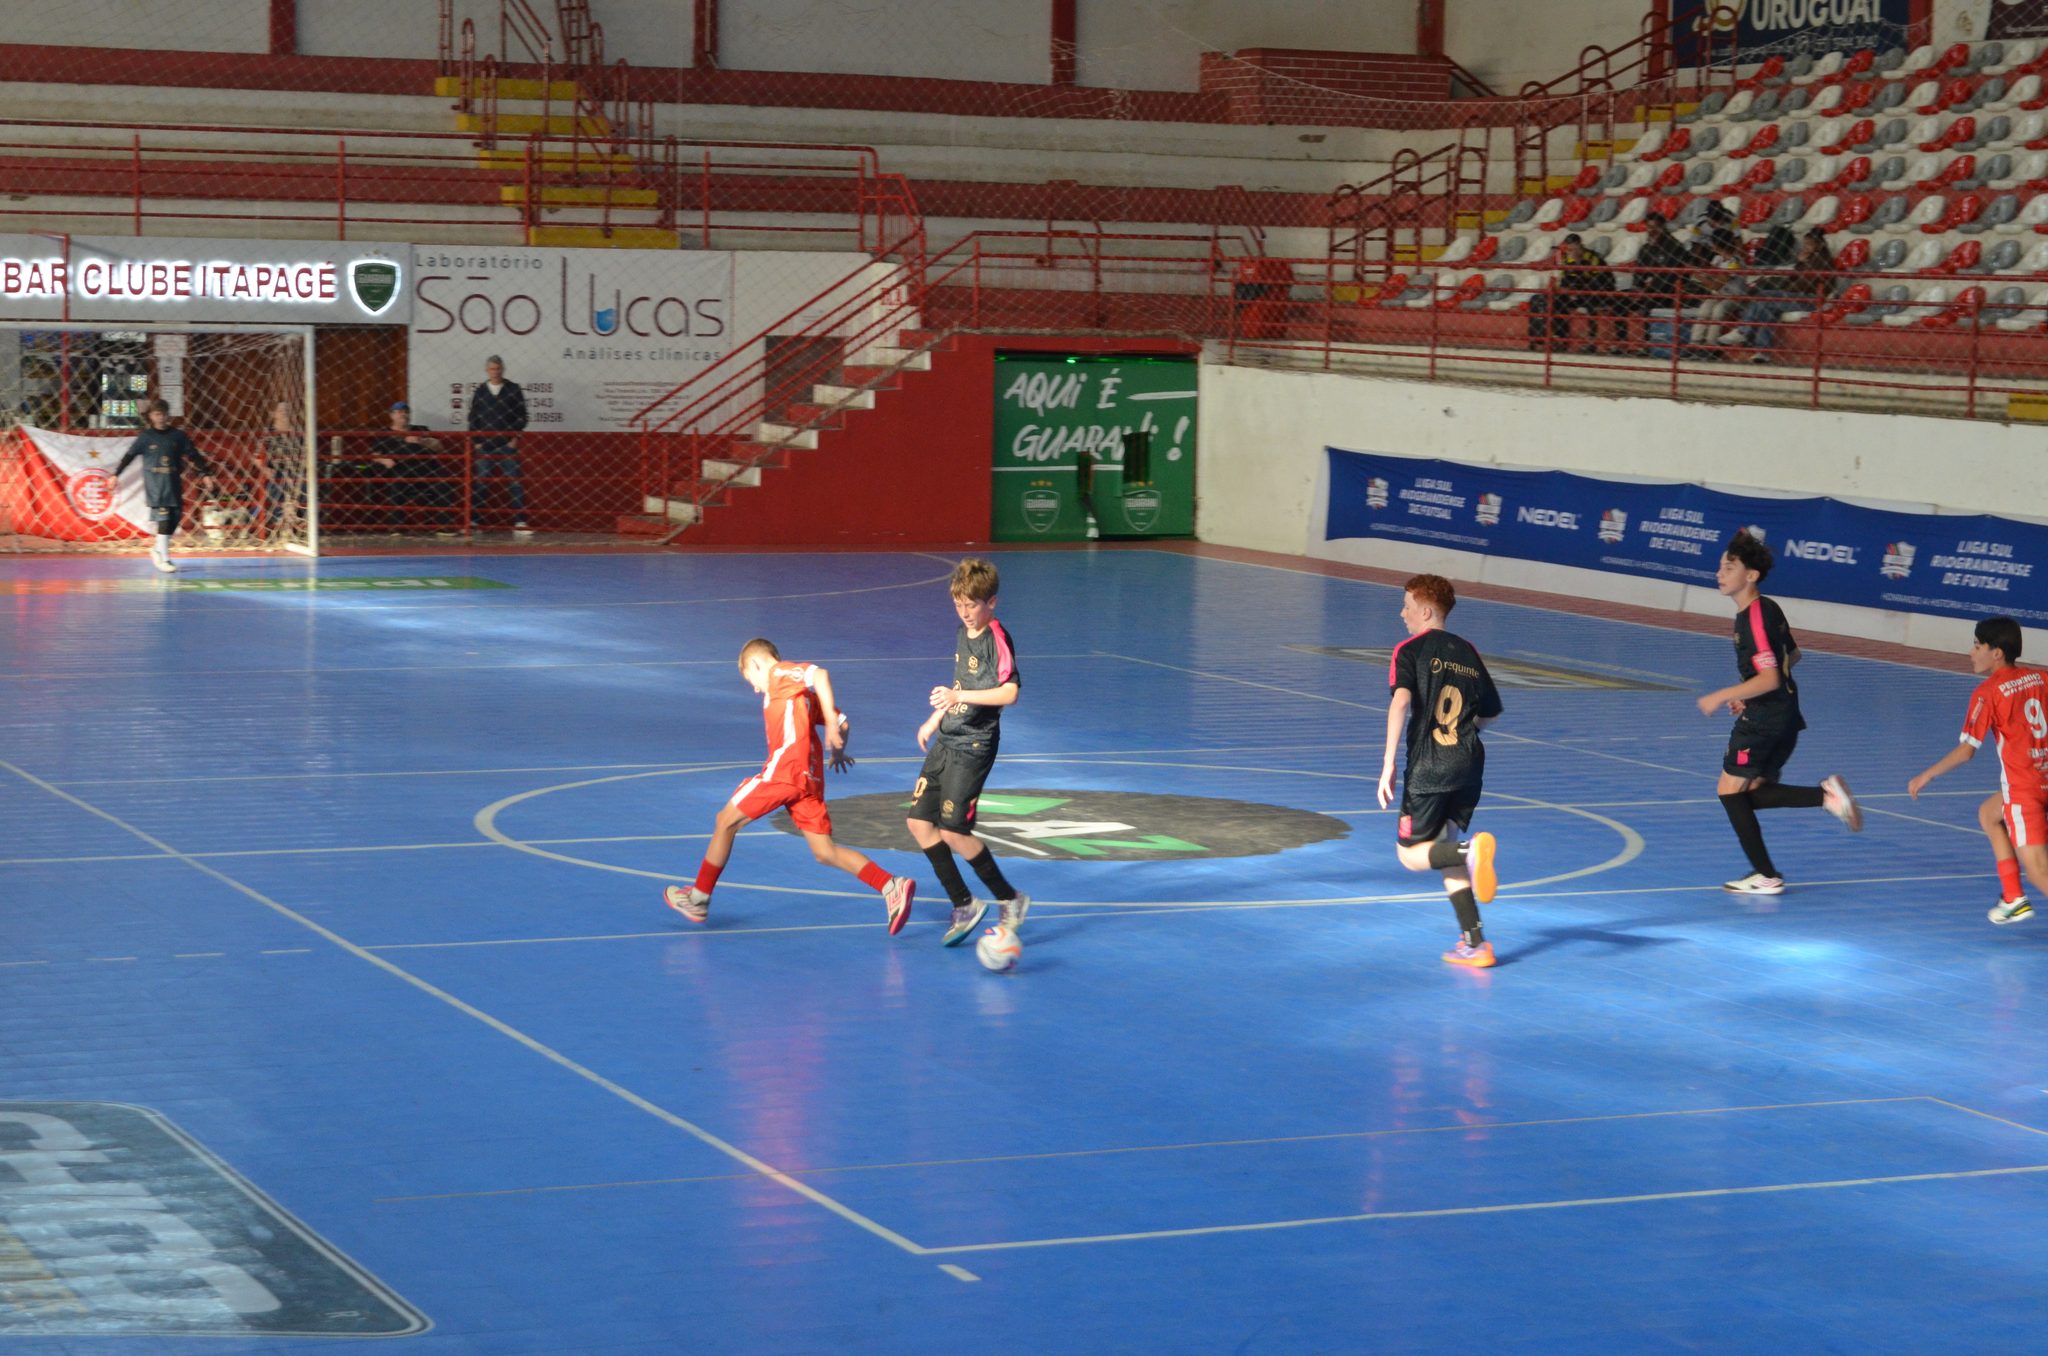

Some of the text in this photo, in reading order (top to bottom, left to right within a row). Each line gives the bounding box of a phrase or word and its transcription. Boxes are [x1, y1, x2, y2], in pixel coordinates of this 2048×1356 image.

[415, 253, 543, 270] Laboratório
[3, 261, 337, 299] BAR CLUBE ITAPAGÉ
[415, 256, 724, 337] São Lucas
[563, 346, 642, 361] Análises
[1517, 506, 1579, 530] NEDEL
[1648, 537, 1665, 549] DE
[1784, 539, 1857, 565] NEDEL
[1956, 540, 2014, 558] LIGA SUL
[1929, 555, 2034, 577] RIOGRANDENSE
[1941, 572, 2010, 591] DE FUTSAL
[1443, 660, 1481, 679] requinte
[1431, 684, 1463, 746] 9
[2024, 697, 2048, 739] 9
